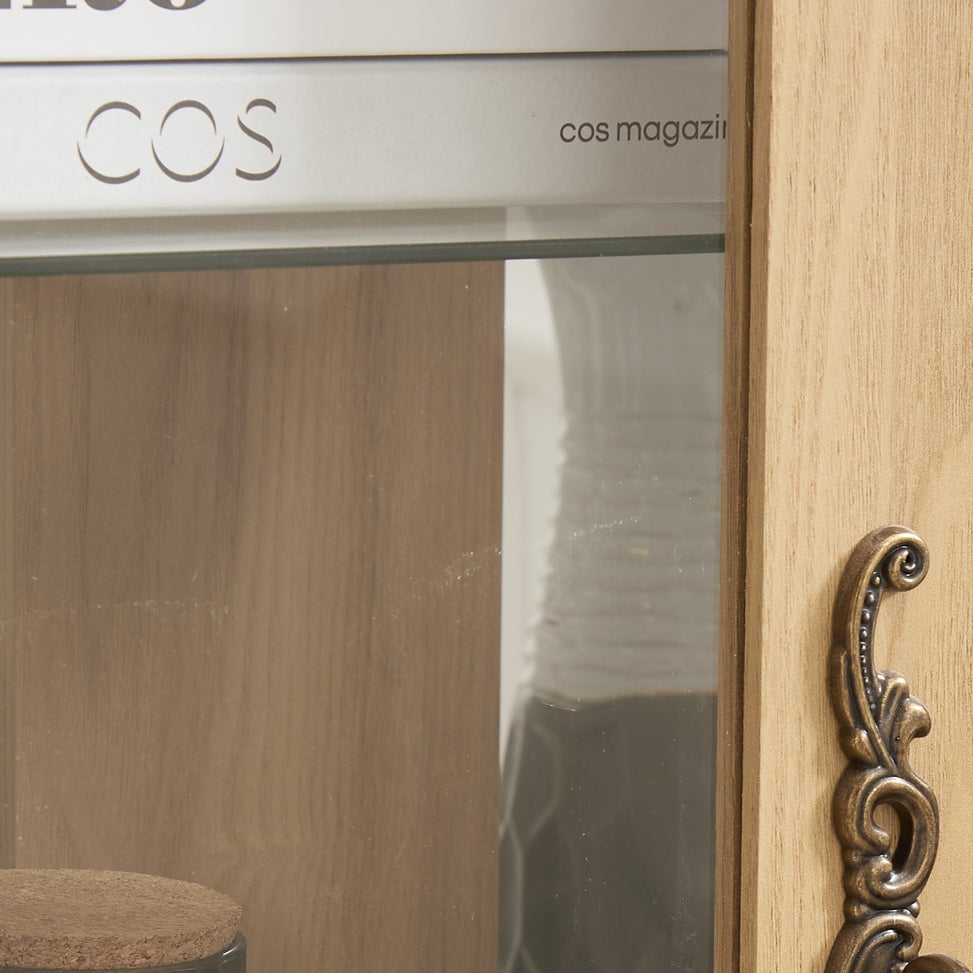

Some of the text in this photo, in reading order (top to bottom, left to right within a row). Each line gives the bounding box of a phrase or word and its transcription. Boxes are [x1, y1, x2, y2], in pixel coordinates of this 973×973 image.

[77, 98, 283, 184] COS
[559, 114, 727, 147] cos magazi
